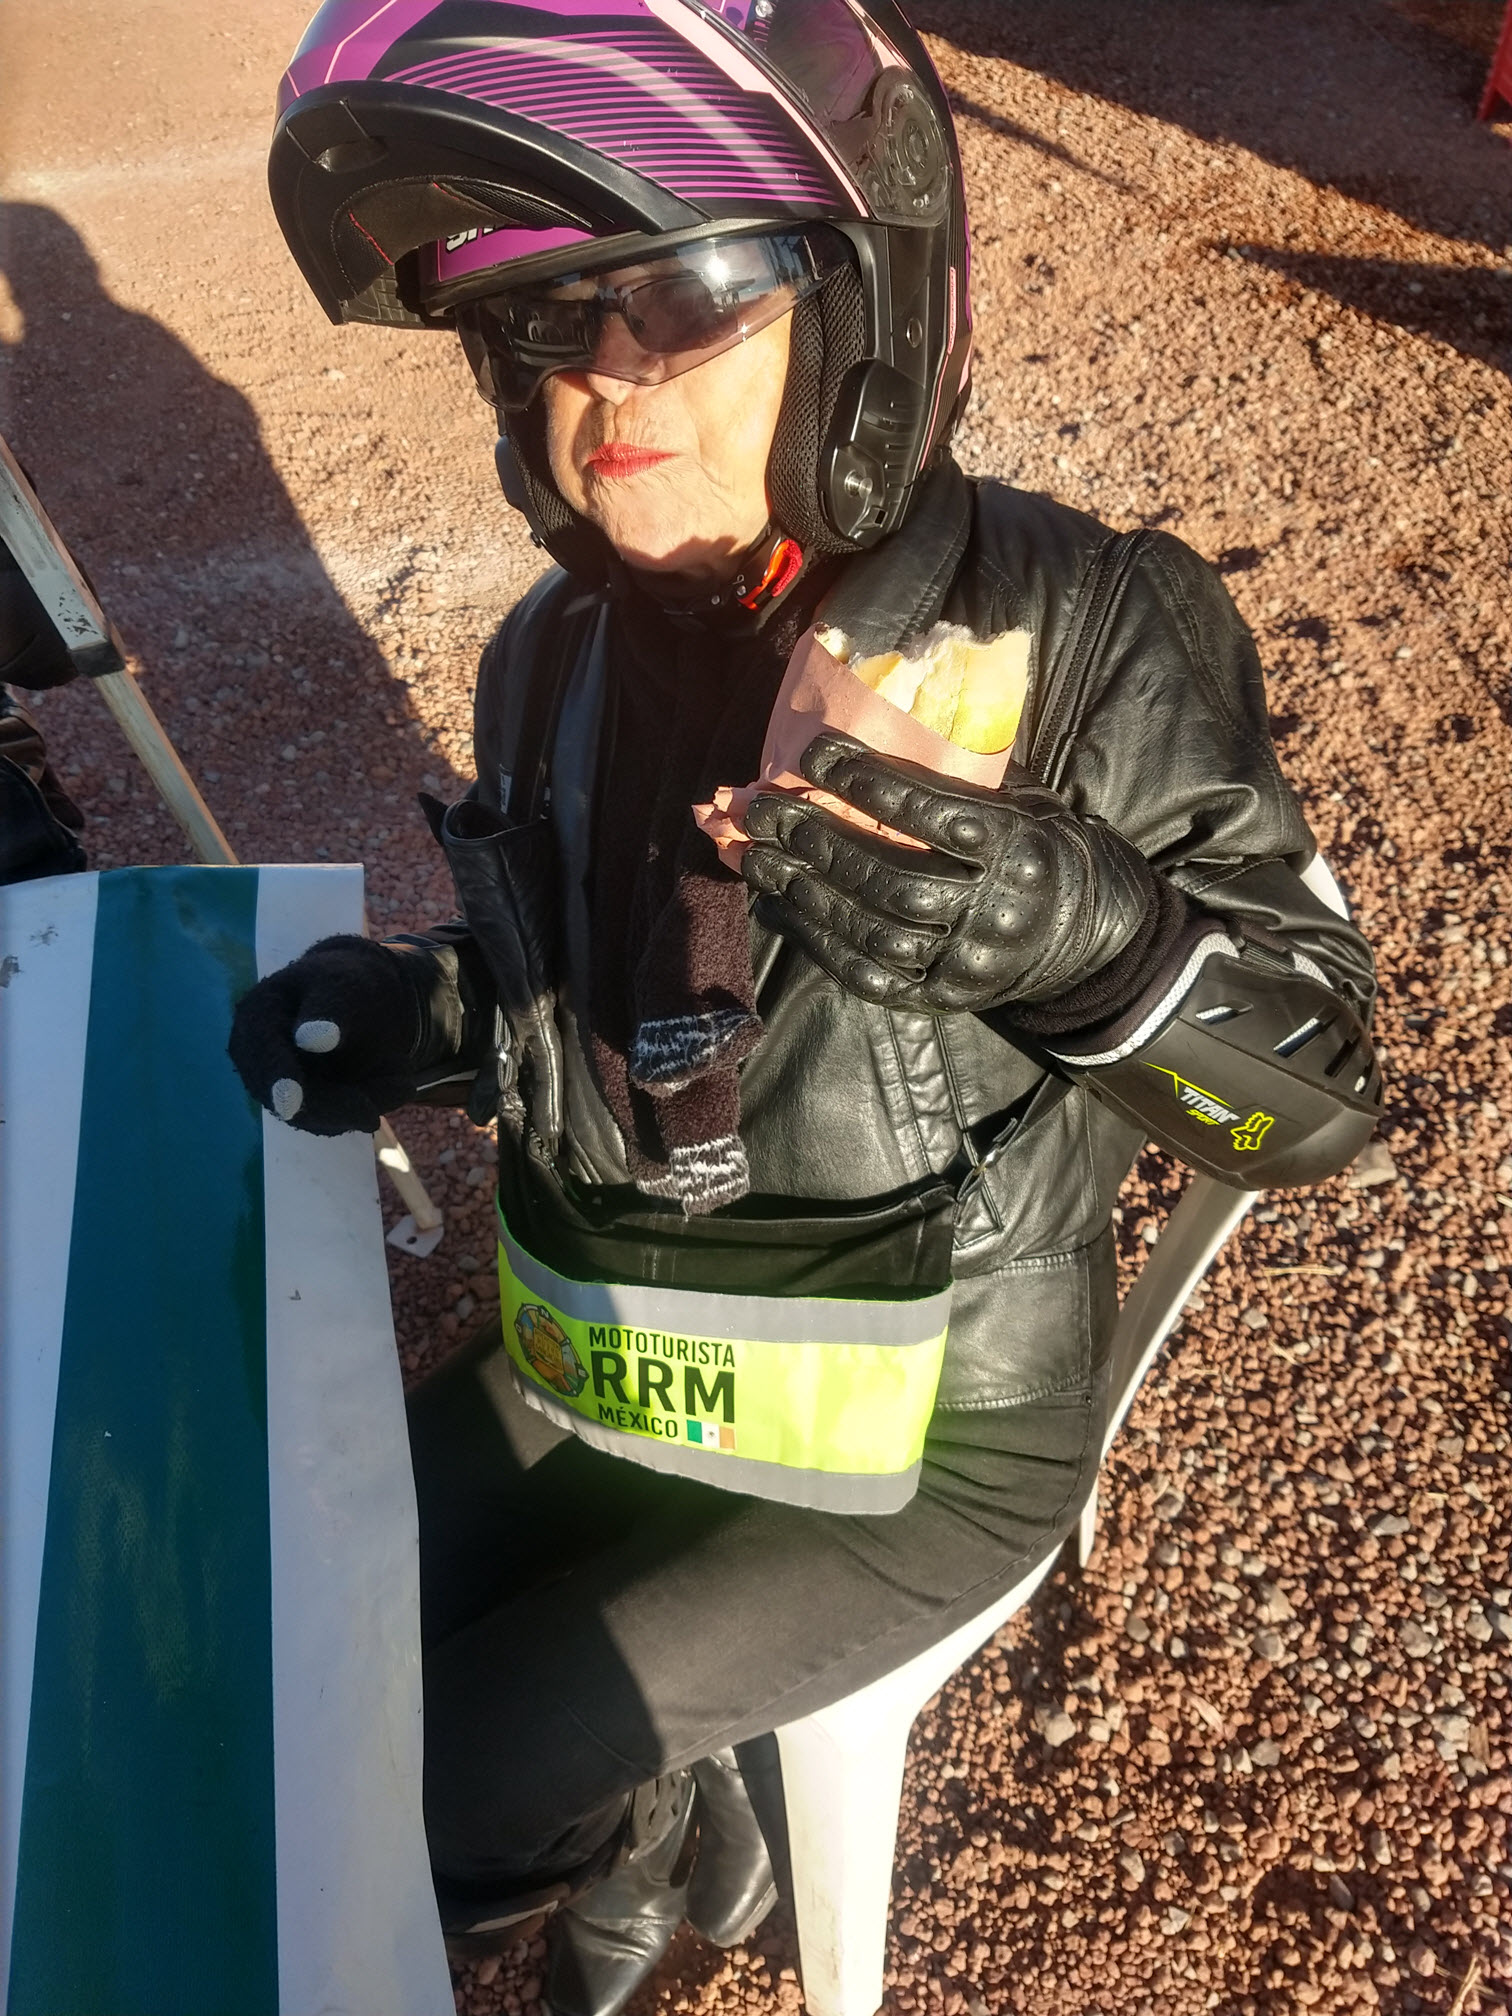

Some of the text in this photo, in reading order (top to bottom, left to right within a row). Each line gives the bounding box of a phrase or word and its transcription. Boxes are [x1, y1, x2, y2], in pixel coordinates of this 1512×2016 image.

[1180, 1087, 1241, 1123] TITAN
[589, 1326, 735, 1368] MOTOTURISTA
[590, 1350, 735, 1424] RRM
[598, 1403, 678, 1438] MÉXICO
